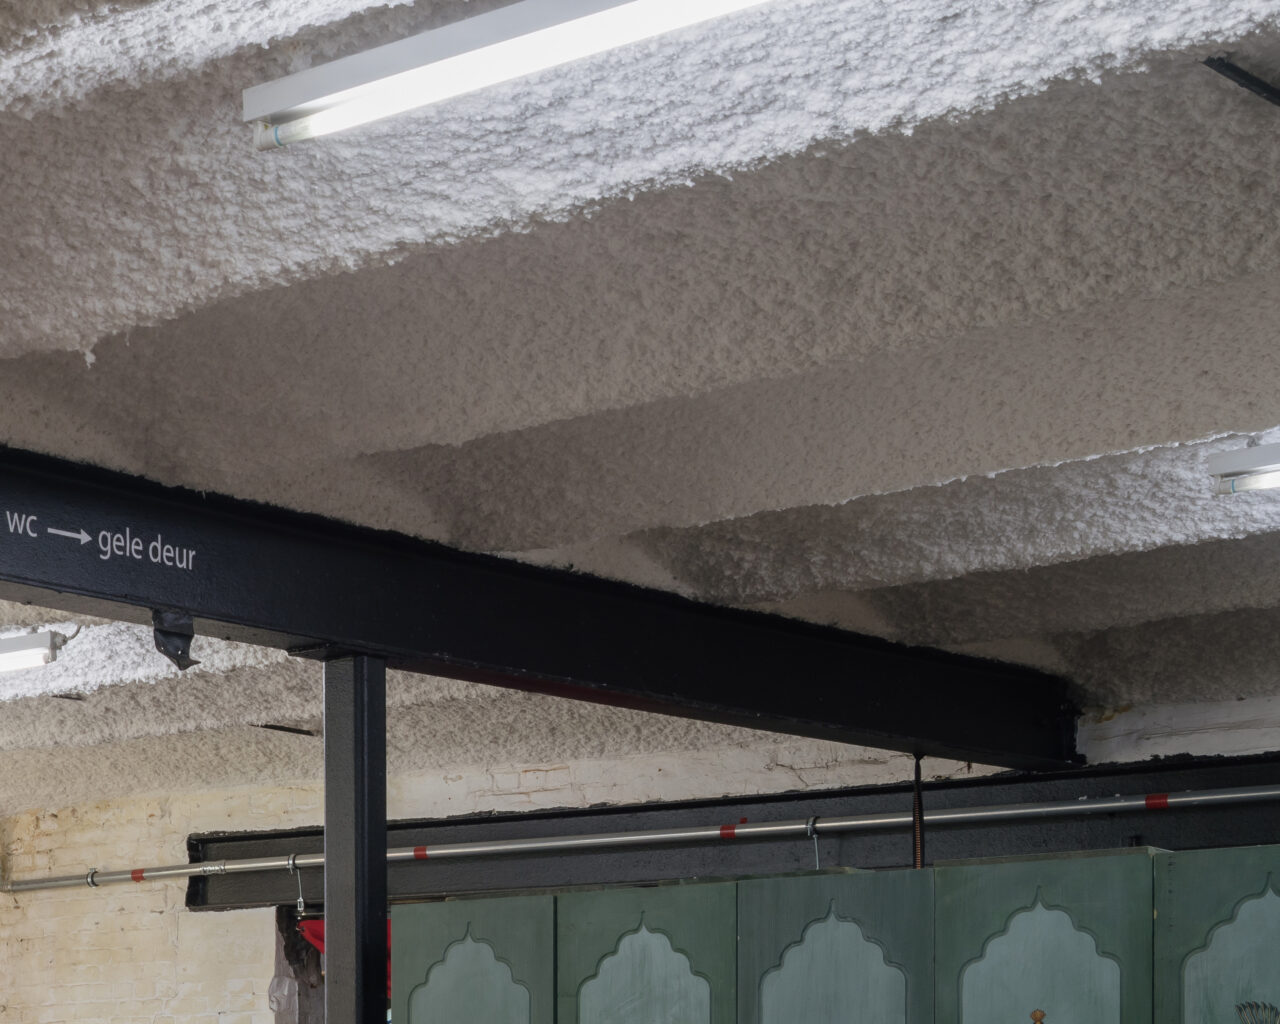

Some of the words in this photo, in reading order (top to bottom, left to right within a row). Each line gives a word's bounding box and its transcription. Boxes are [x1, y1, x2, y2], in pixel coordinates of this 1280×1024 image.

[6, 510, 38, 538] WC
[98, 526, 144, 560] gele
[148, 533, 197, 570] deur
